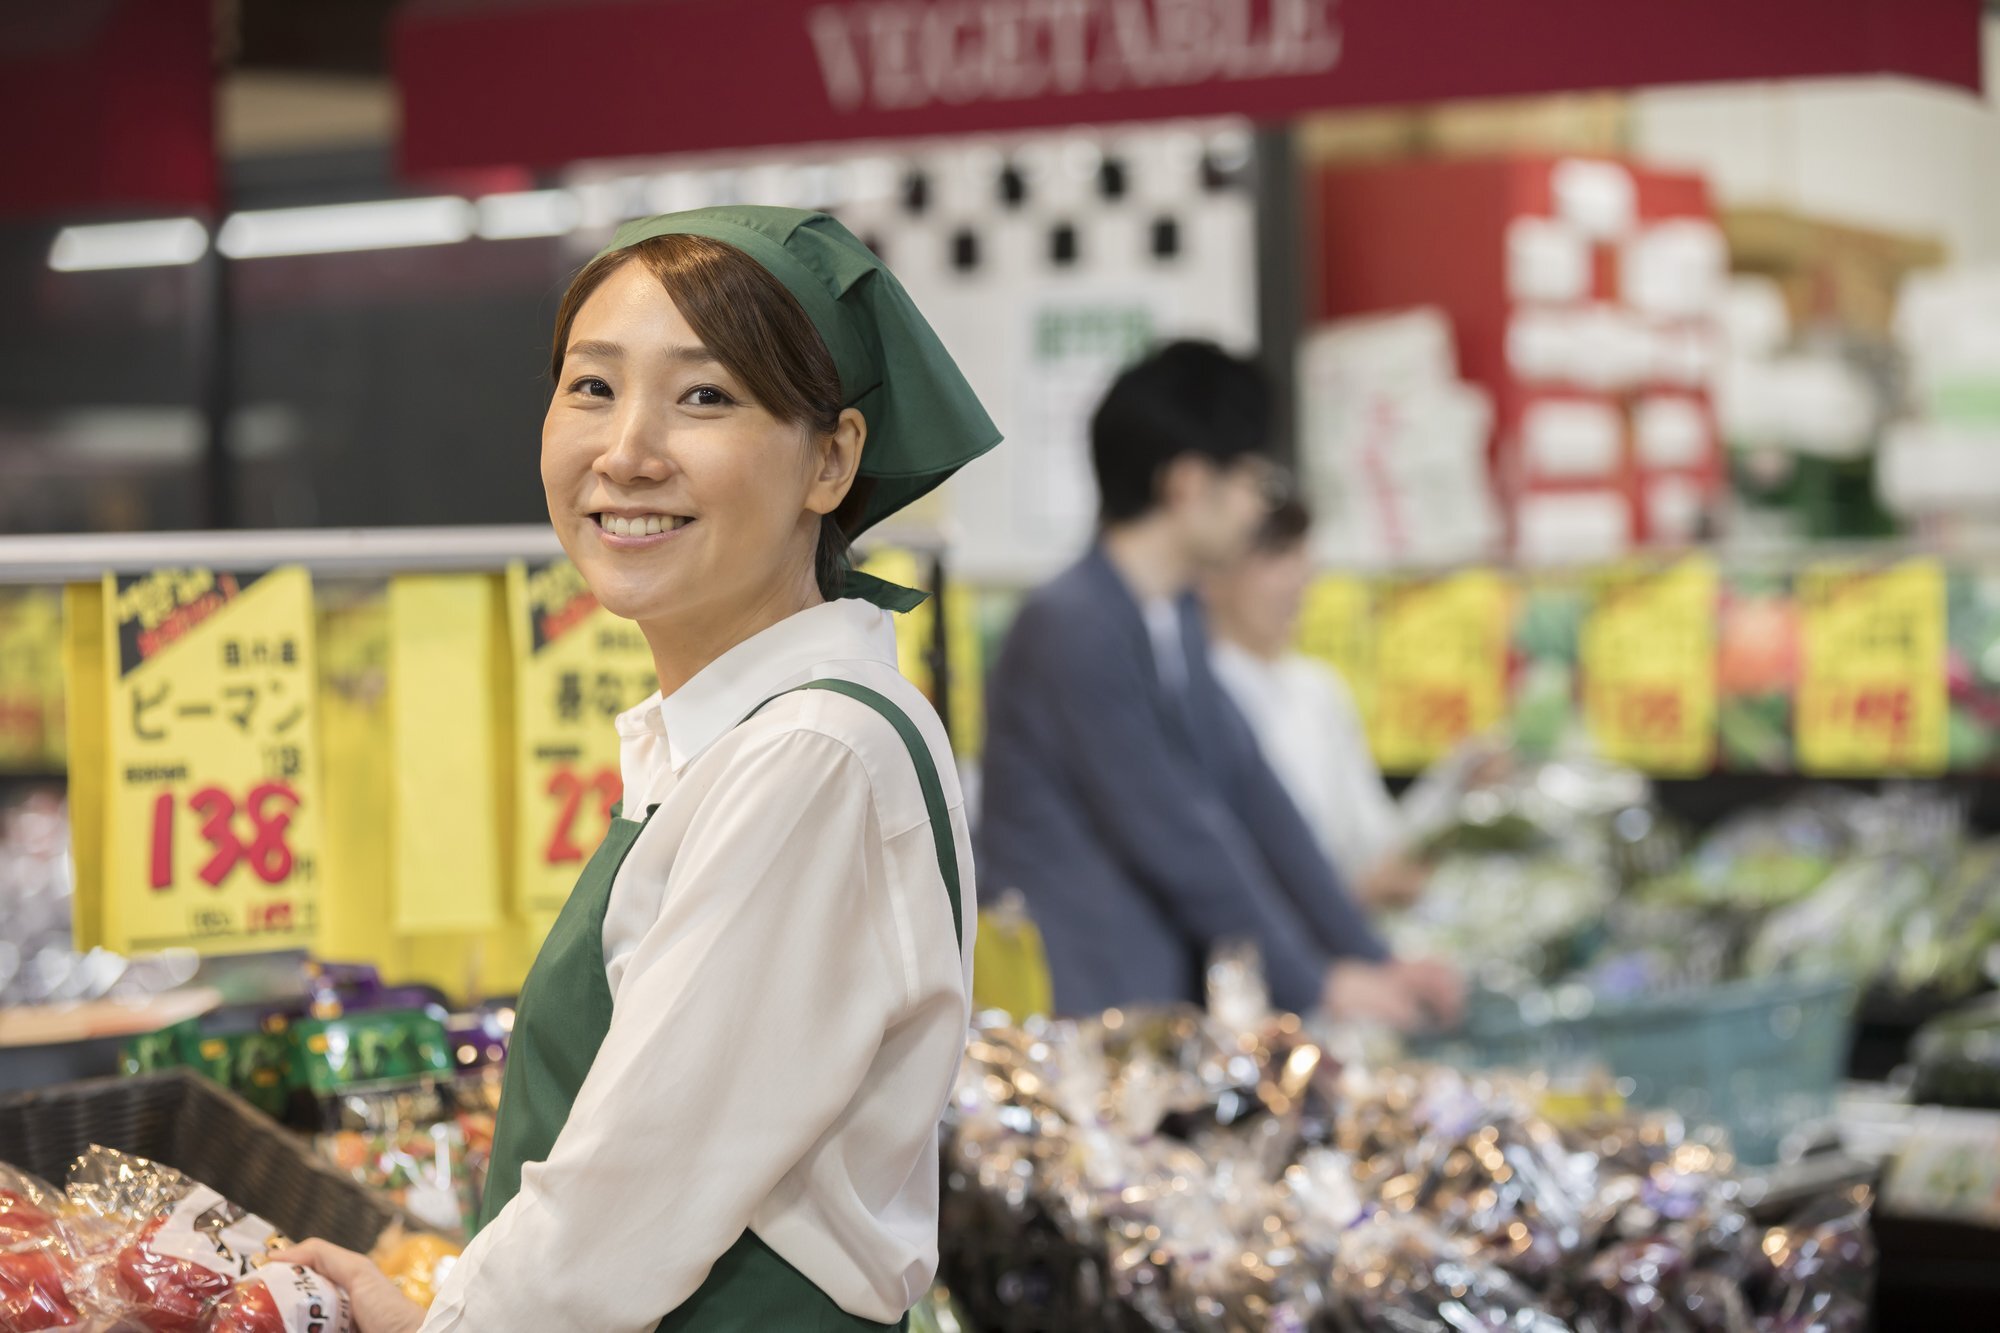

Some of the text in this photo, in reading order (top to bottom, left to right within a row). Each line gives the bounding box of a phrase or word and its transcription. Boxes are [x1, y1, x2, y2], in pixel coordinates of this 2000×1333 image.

[808, 0, 1342, 110] VEGETABLE
[131, 684, 305, 740] ピーマン
[150, 782, 302, 890] 138
